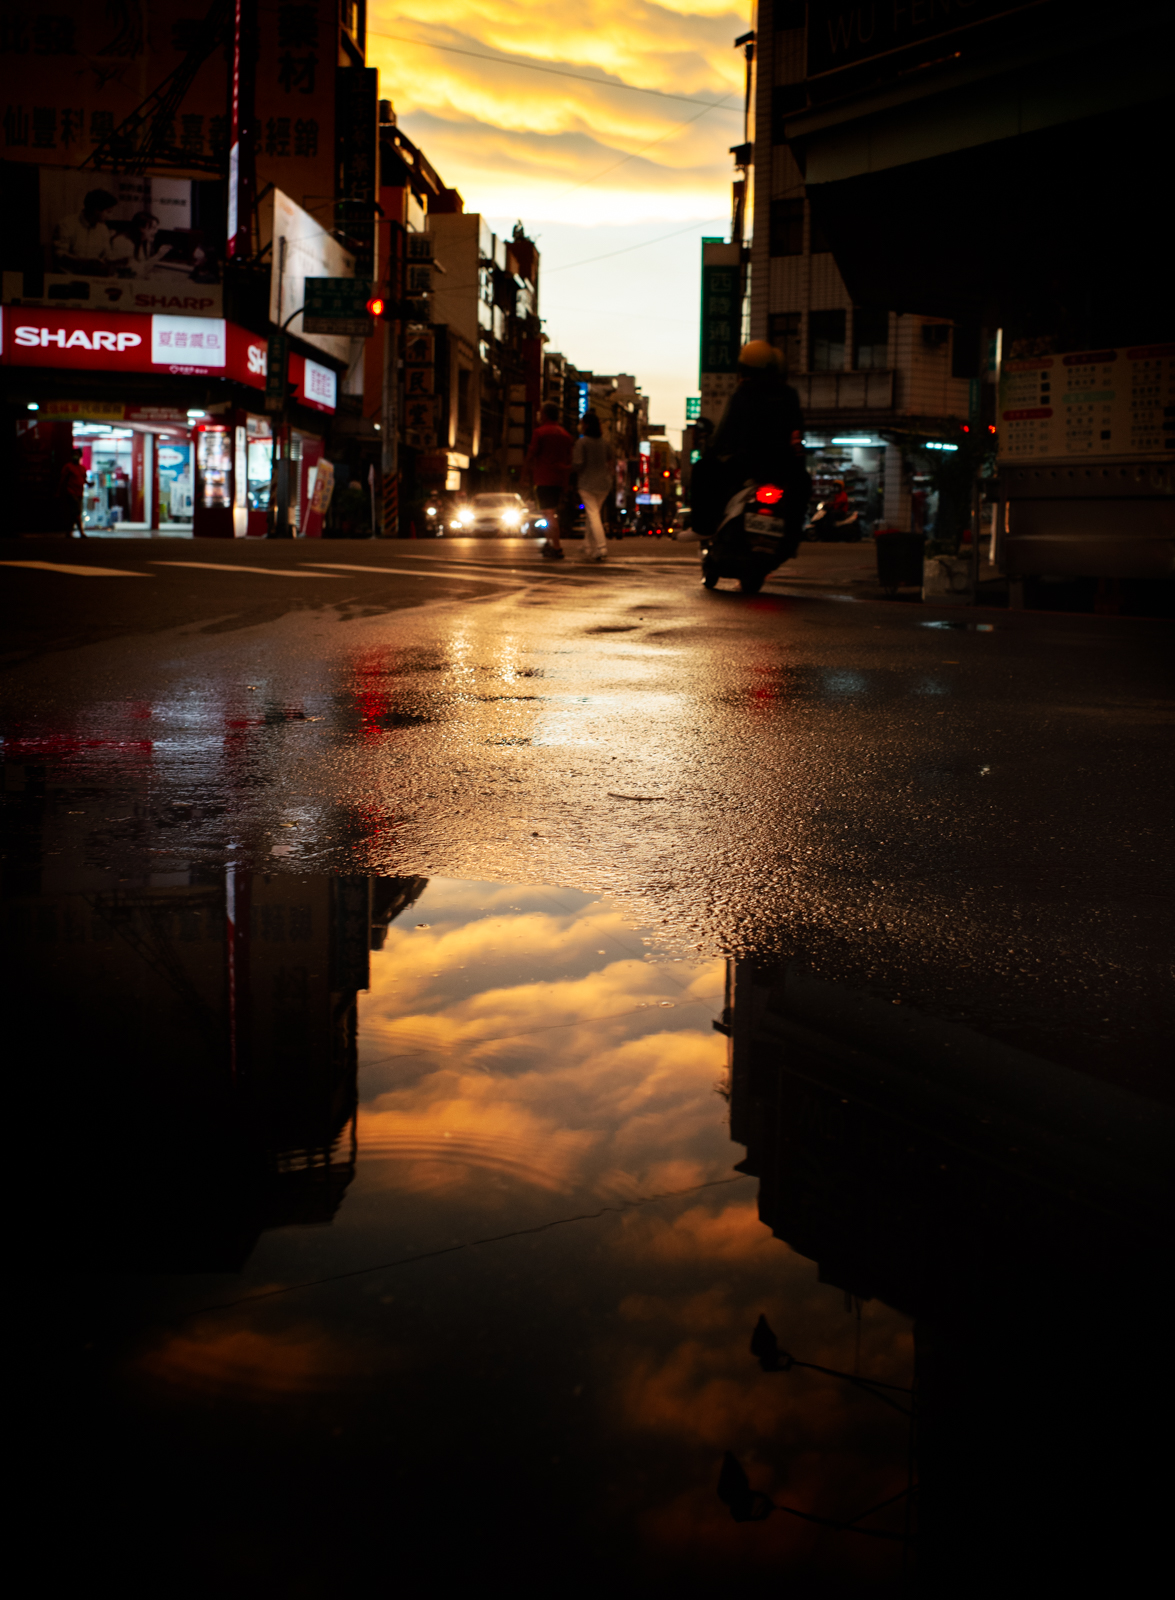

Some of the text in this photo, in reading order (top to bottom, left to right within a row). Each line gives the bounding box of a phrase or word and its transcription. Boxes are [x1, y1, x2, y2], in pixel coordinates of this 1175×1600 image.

[826, 3, 876, 55] WU
[135, 294, 215, 311] SHARP
[14, 325, 142, 353] SHARP
[158, 331, 220, 349] 夏普震旦
[247, 344, 267, 377] SH
